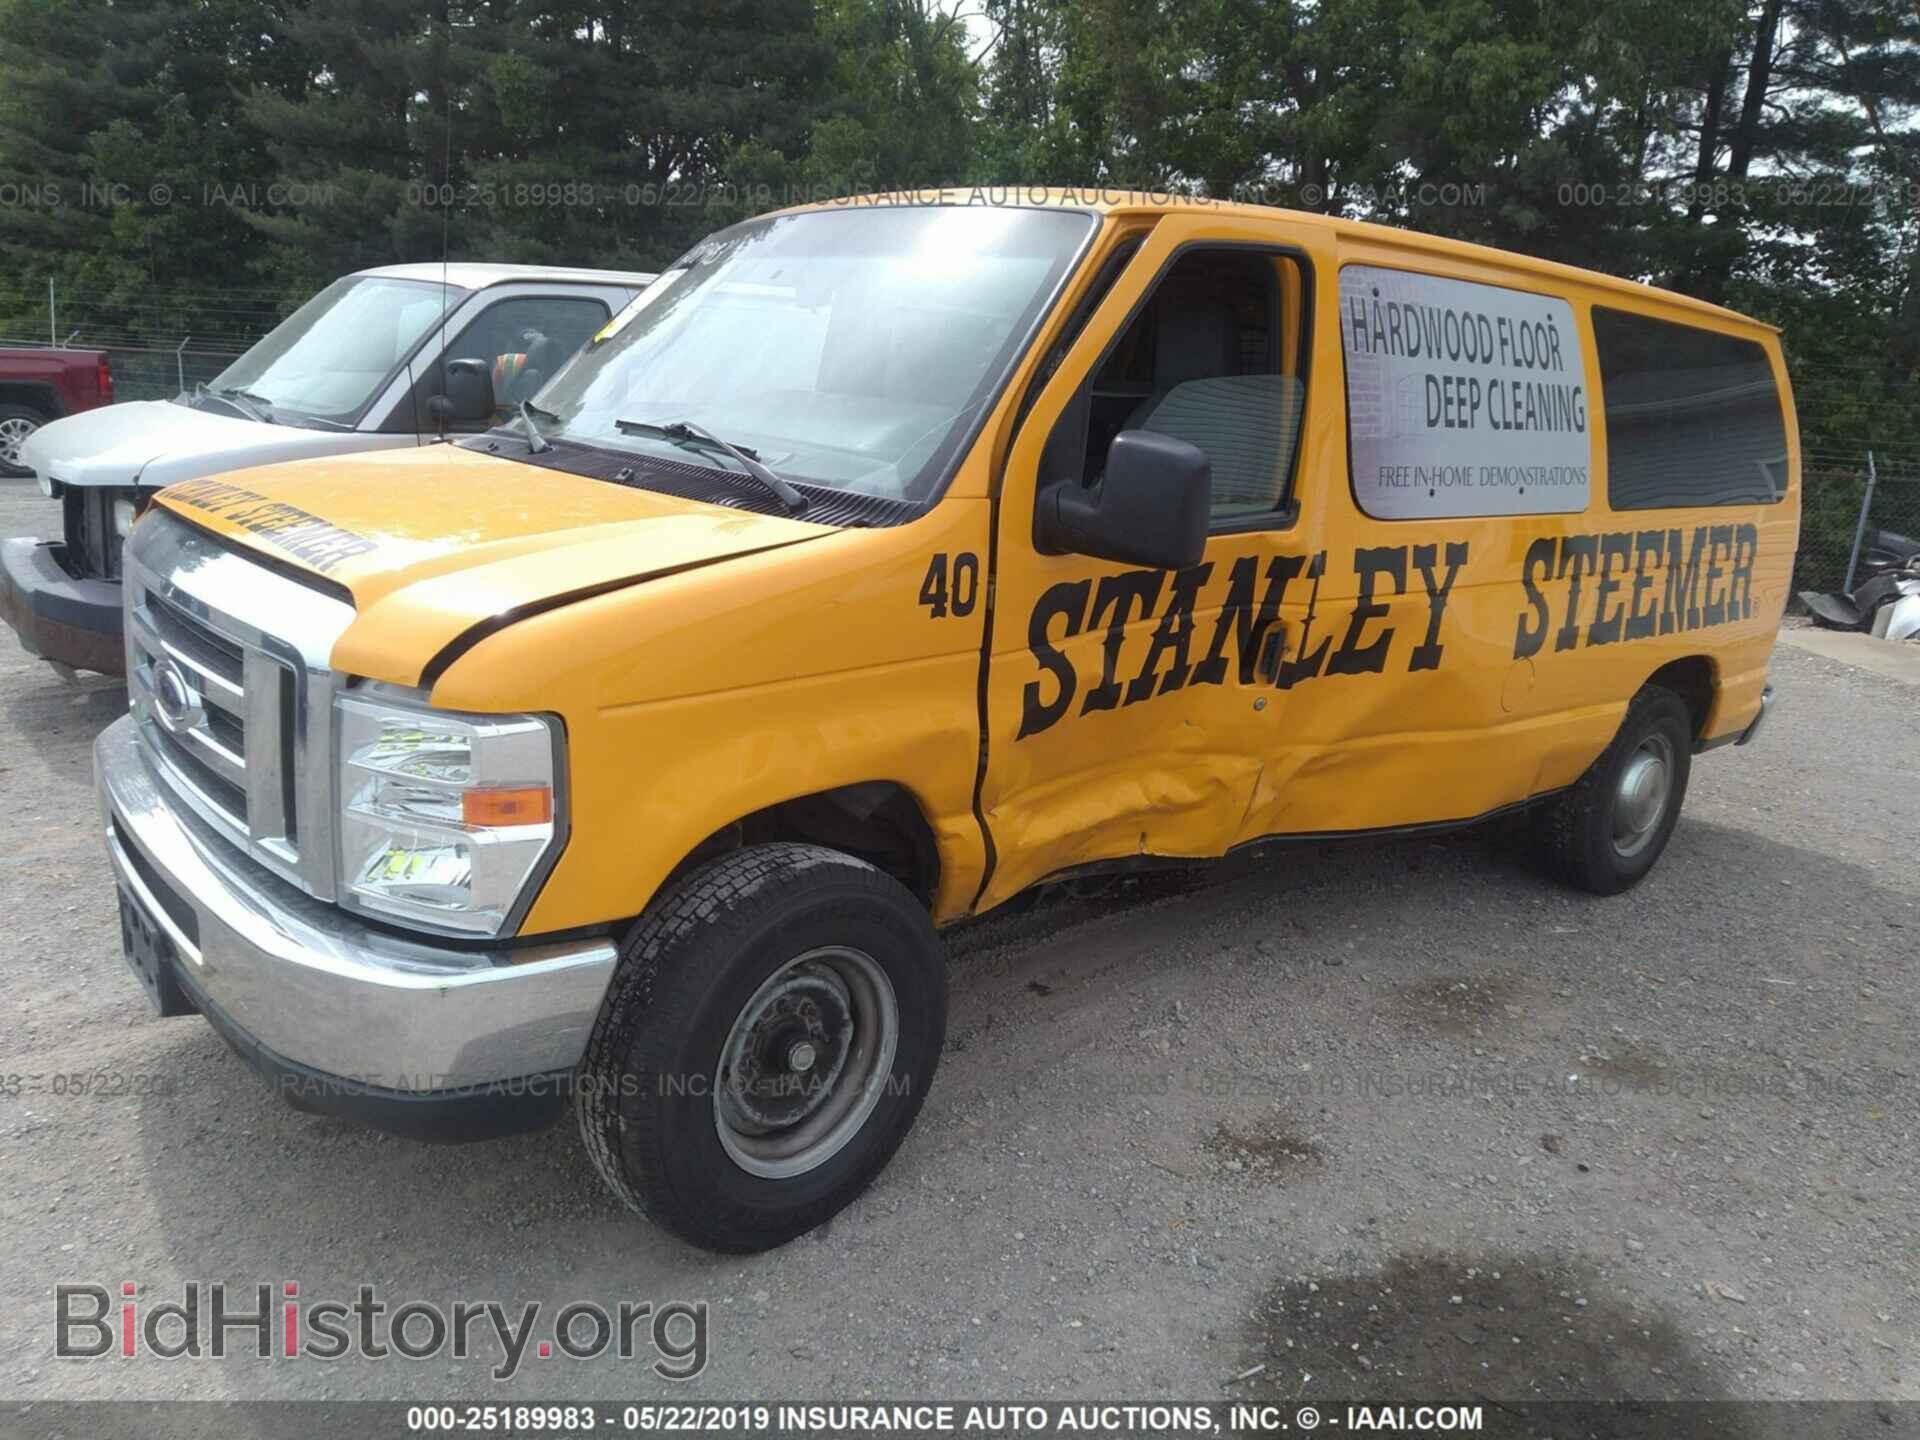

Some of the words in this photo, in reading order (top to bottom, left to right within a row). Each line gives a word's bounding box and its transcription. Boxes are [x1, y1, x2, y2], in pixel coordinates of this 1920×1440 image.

[1350, 296, 1494, 365] HARDWOOD
[1498, 317, 1564, 372] FLOOR
[1425, 374, 1481, 428] DEEP
[1488, 378, 1586, 433] CLEANING
[1378, 466, 1411, 488] FREE
[1414, 466, 1473, 488] IN-HOME
[1480, 465, 1587, 487] DEMONSTRATIONS
[918, 552, 979, 619] 40
[1015, 541, 1469, 741] STANLEY
[1513, 523, 1757, 659] STEEMER
